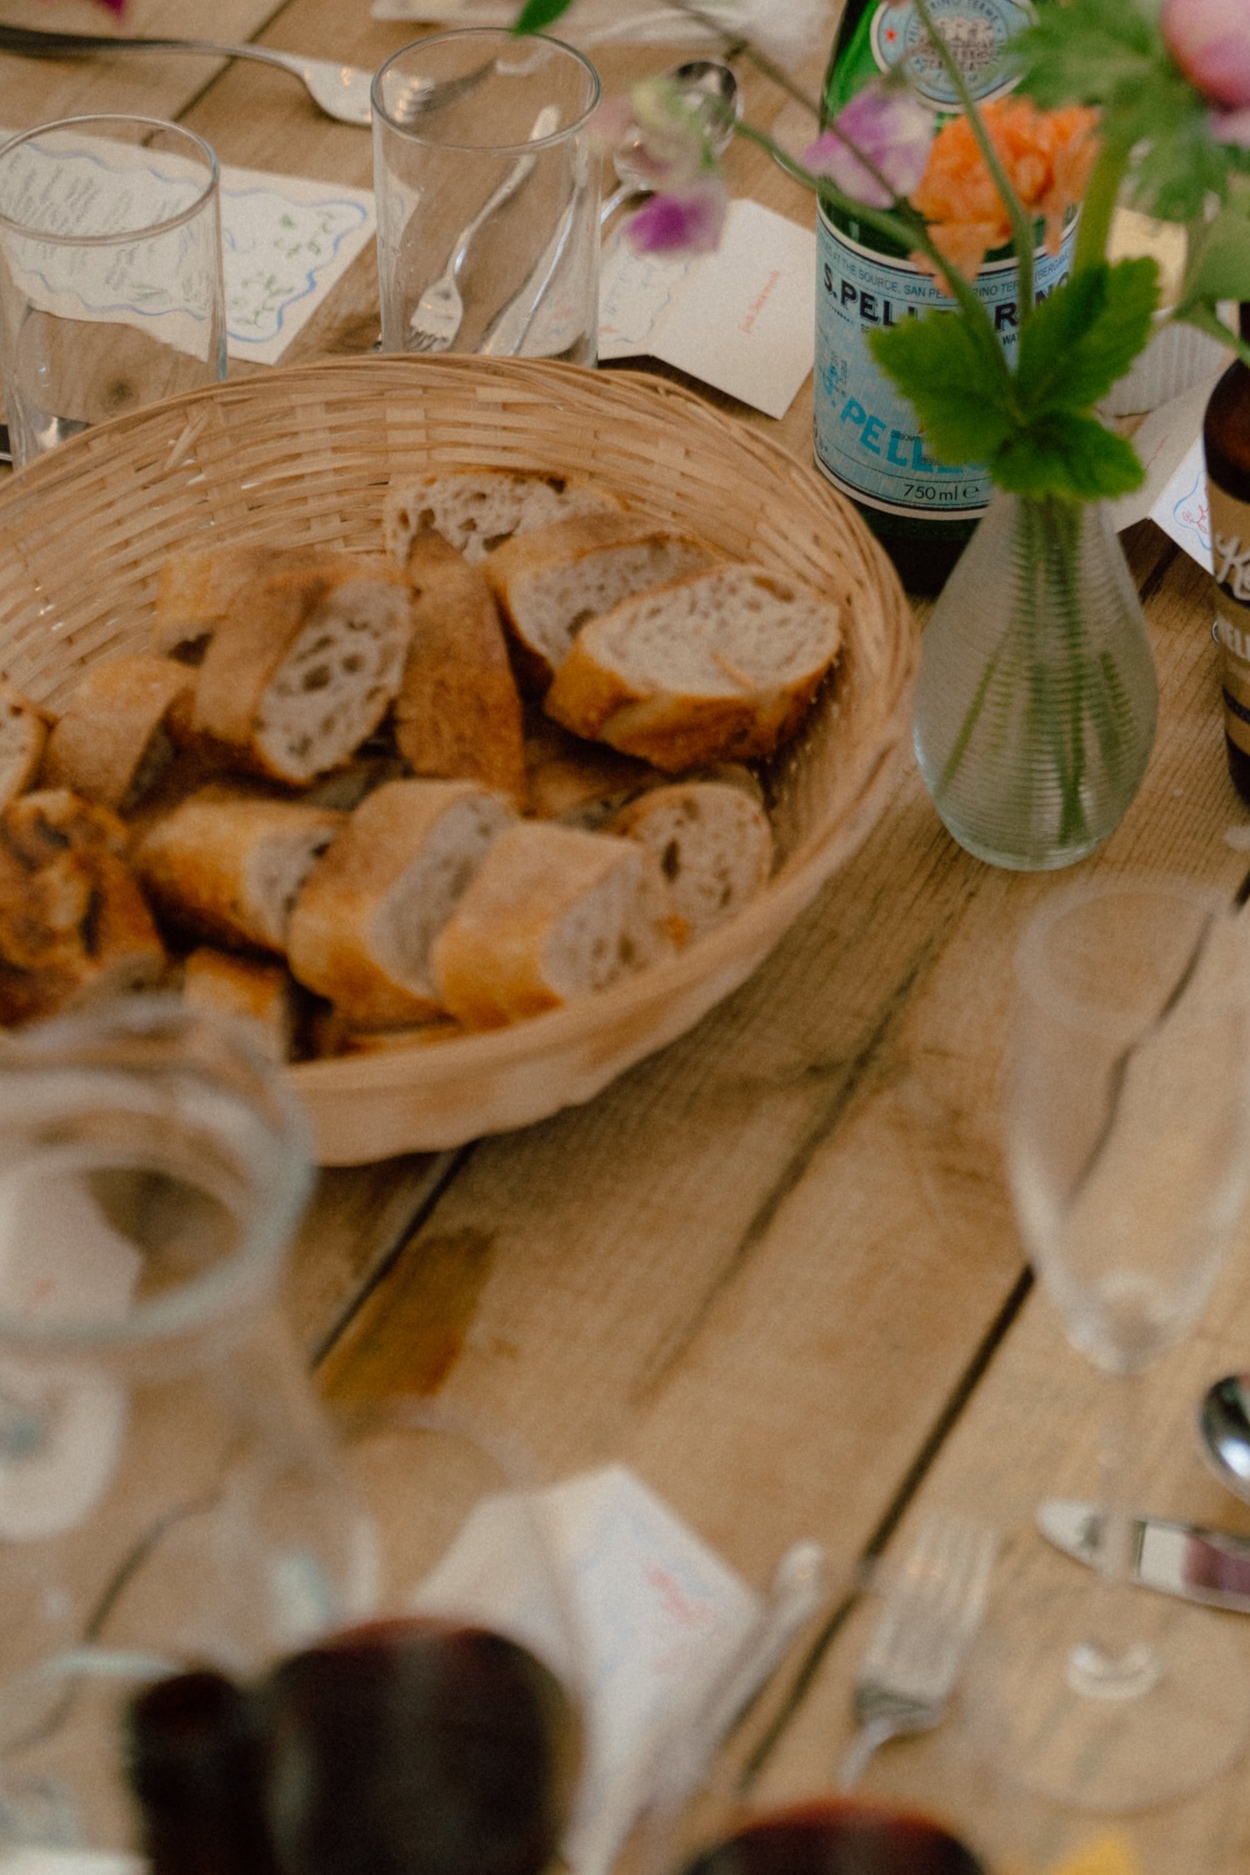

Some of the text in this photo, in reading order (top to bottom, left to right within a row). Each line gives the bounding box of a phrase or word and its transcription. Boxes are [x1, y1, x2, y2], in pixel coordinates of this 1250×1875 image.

[903, 284, 926, 297] SAN
[904, 483, 936, 501] 750
[939, 486, 958, 501] ml
